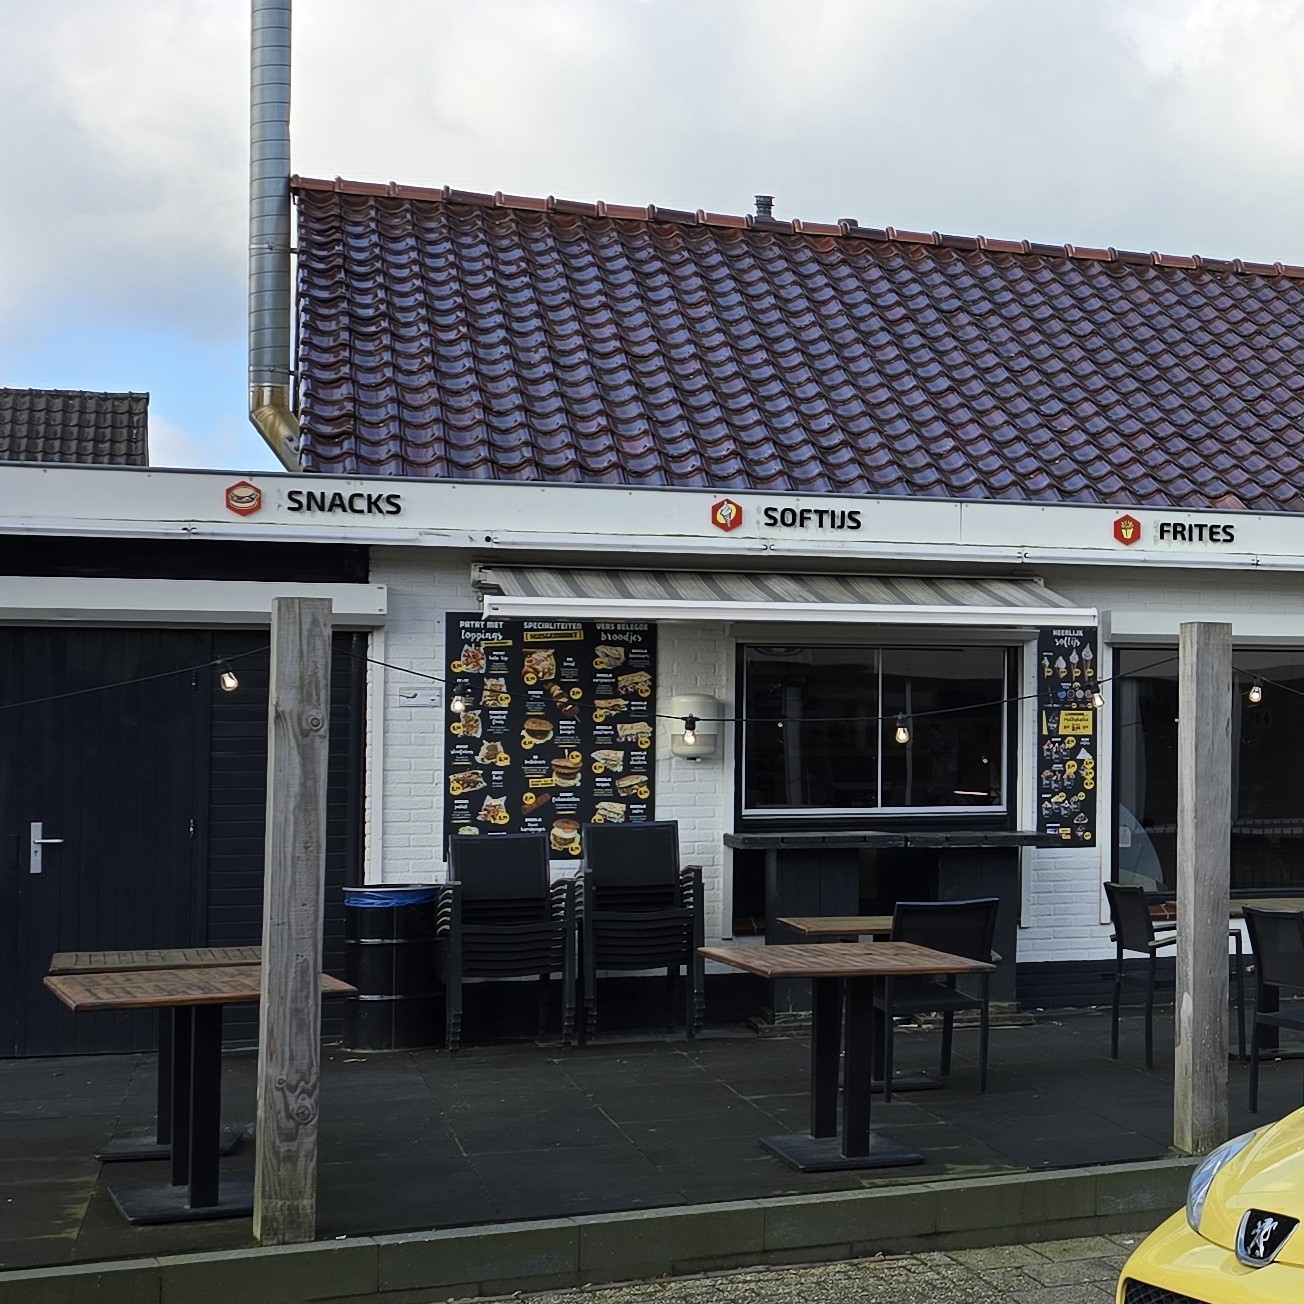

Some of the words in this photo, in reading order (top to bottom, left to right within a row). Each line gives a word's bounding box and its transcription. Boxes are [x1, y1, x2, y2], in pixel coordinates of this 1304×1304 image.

[286, 490, 402, 515] SNACKS
[763, 506, 862, 530] SOFTIJS
[1159, 522, 1235, 543] FRITES
[460, 620, 485, 629] PATAT
[486, 621, 504, 629] MET
[523, 621, 582, 630] SPECIALITEITEN
[461, 629, 503, 642] toppings
[600, 632, 642, 644] broodjes
[1053, 629, 1084, 637] HEERLIJK
